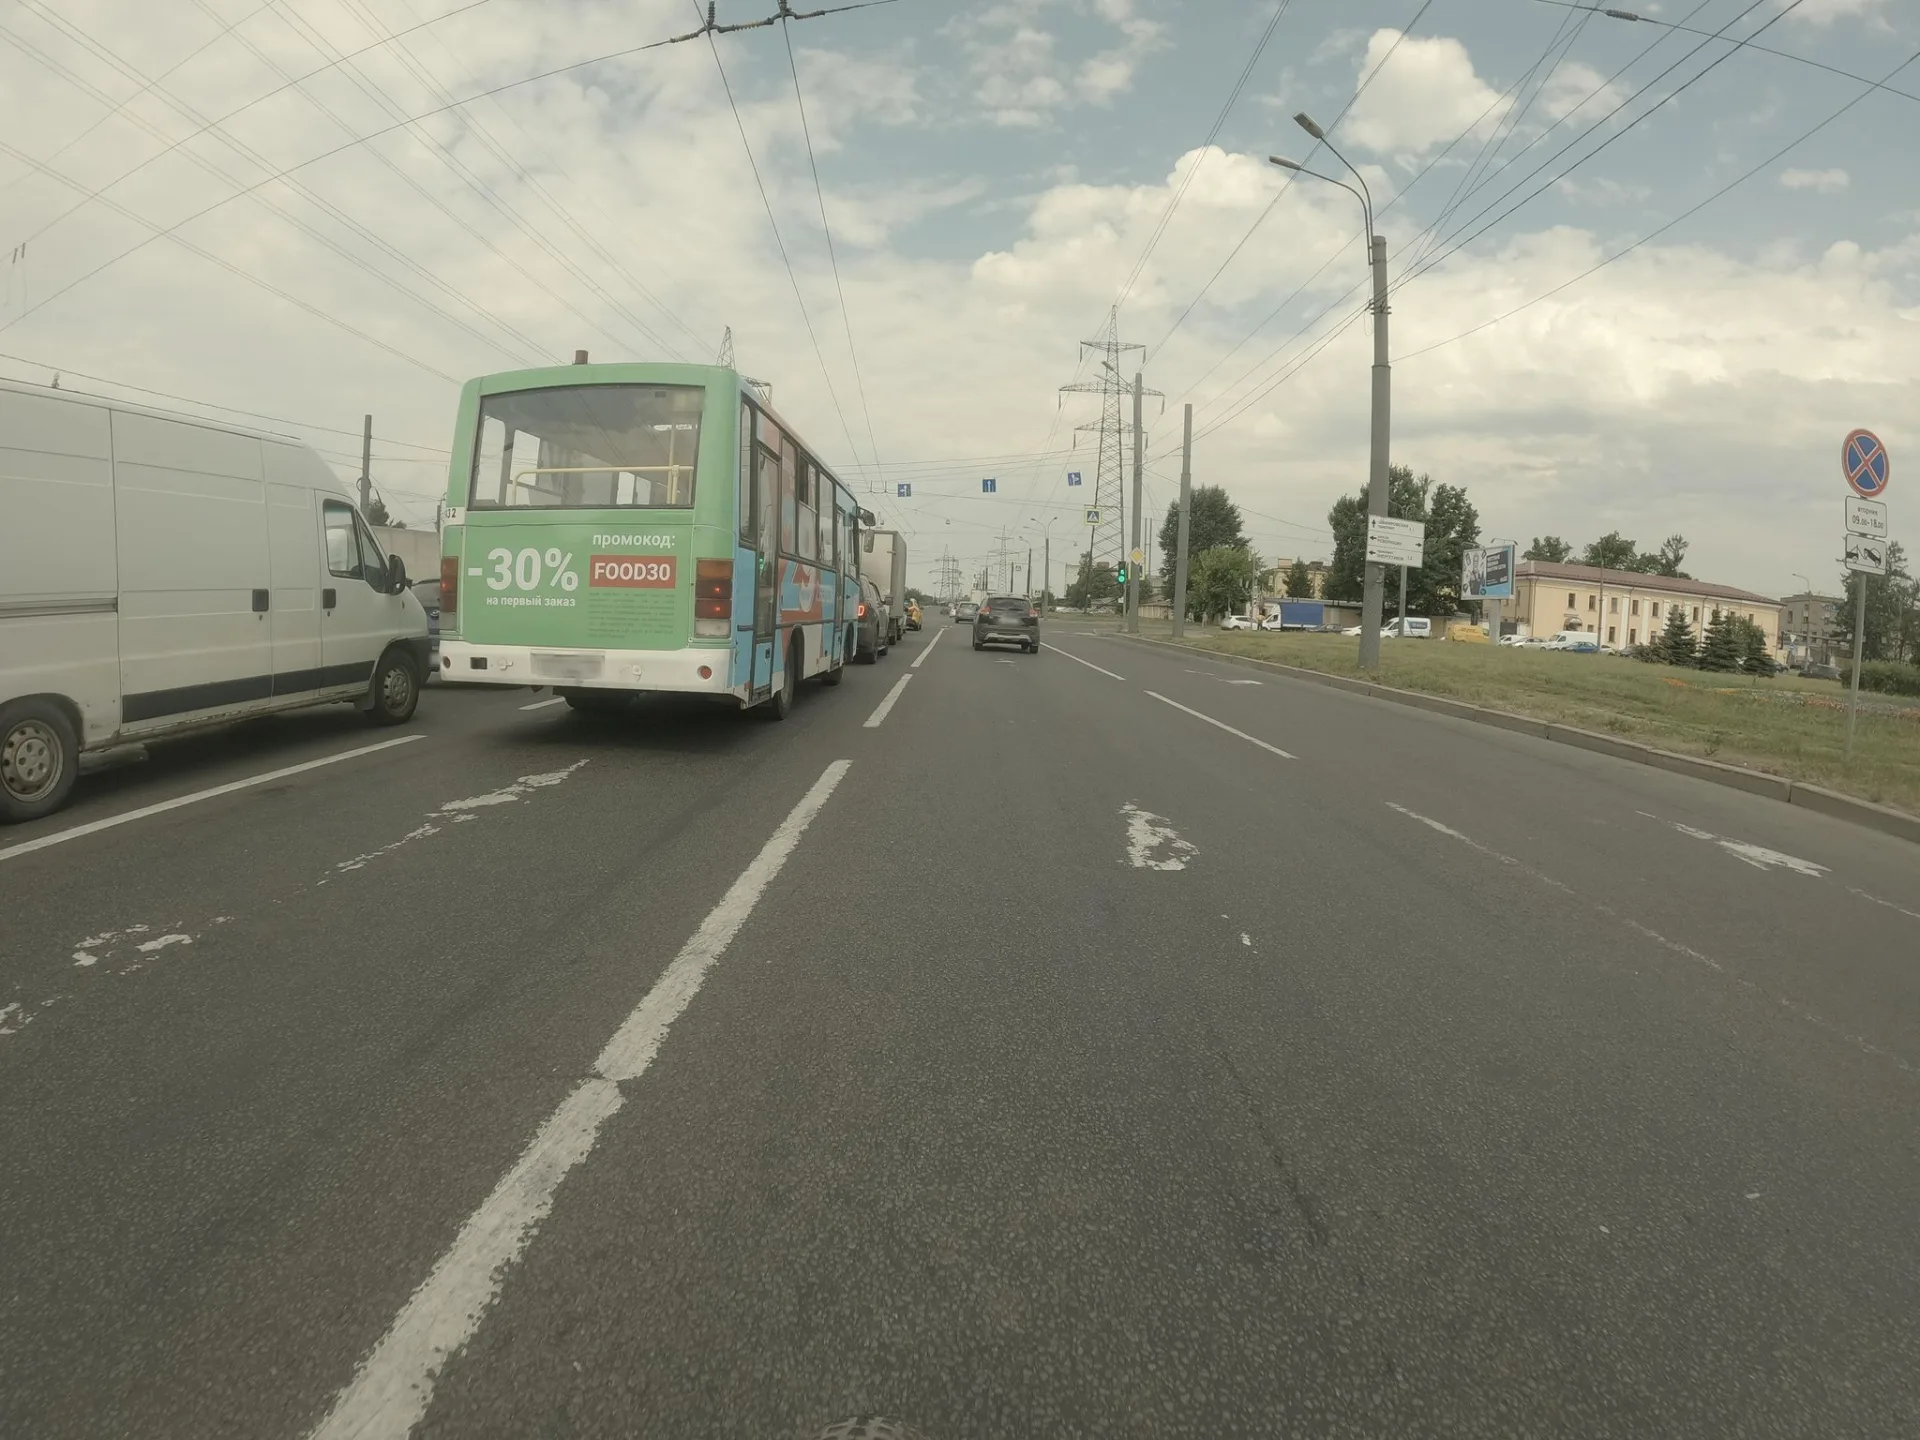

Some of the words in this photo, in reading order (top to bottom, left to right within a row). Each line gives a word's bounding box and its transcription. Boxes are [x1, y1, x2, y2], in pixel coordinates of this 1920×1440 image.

[592, 534, 675, 549] промокод:
[467, 547, 578, 592] -30%
[594, 563, 670, 581] FOOD30
[486, 597, 499, 606] на
[501, 595, 541, 608] первый
[544, 598, 576, 607] заказ
